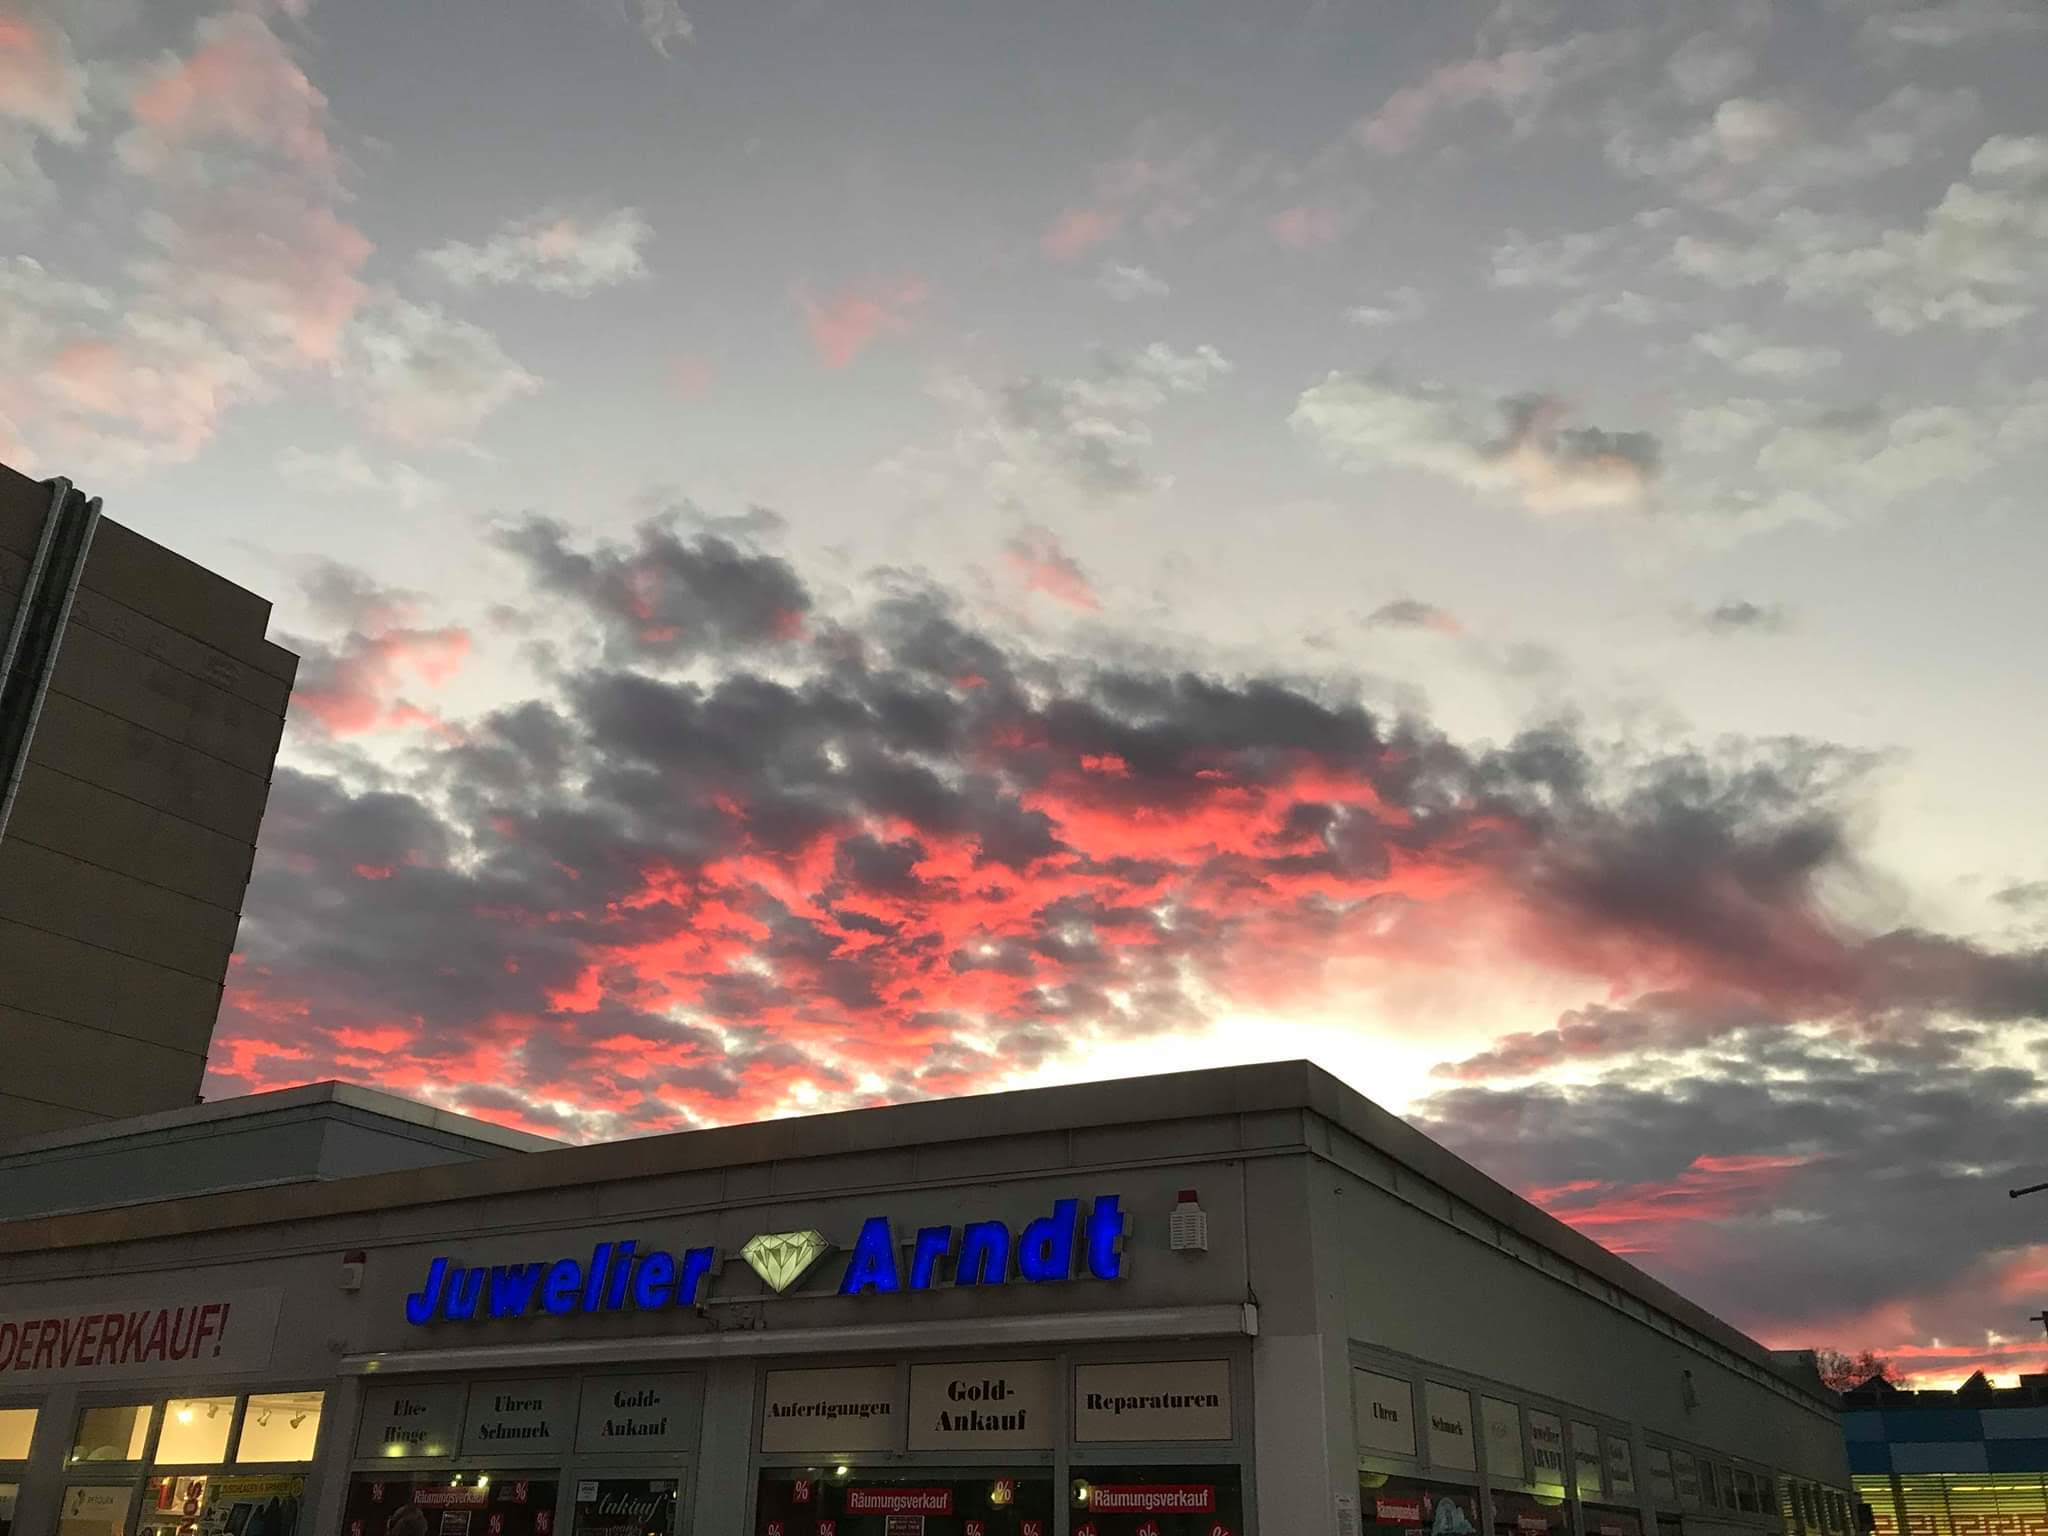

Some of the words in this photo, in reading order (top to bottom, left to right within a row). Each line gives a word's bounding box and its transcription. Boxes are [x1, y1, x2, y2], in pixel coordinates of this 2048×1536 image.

[406, 1240, 714, 1328] Juwelier
[838, 1195, 1124, 1296] Arndt
[0, 1303, 230, 1372] DERVERKAUF!
[613, 1389, 661, 1408] Gold-
[947, 1379, 1015, 1402] Gold-
[494, 1395, 543, 1413] Uhren
[768, 1400, 891, 1419] Anfertigungen
[1086, 1391, 1219, 1413] Reparaturen
[478, 1421, 551, 1441] Schmuck
[602, 1417, 668, 1438] Ankauf
[934, 1408, 1027, 1433] Ankauf
[413, 1487, 486, 1507] Räumungsverkauf
[850, 1492, 949, 1512] Räumungsverkauf
[1094, 1488, 1209, 1510] Räumungsverkauf
